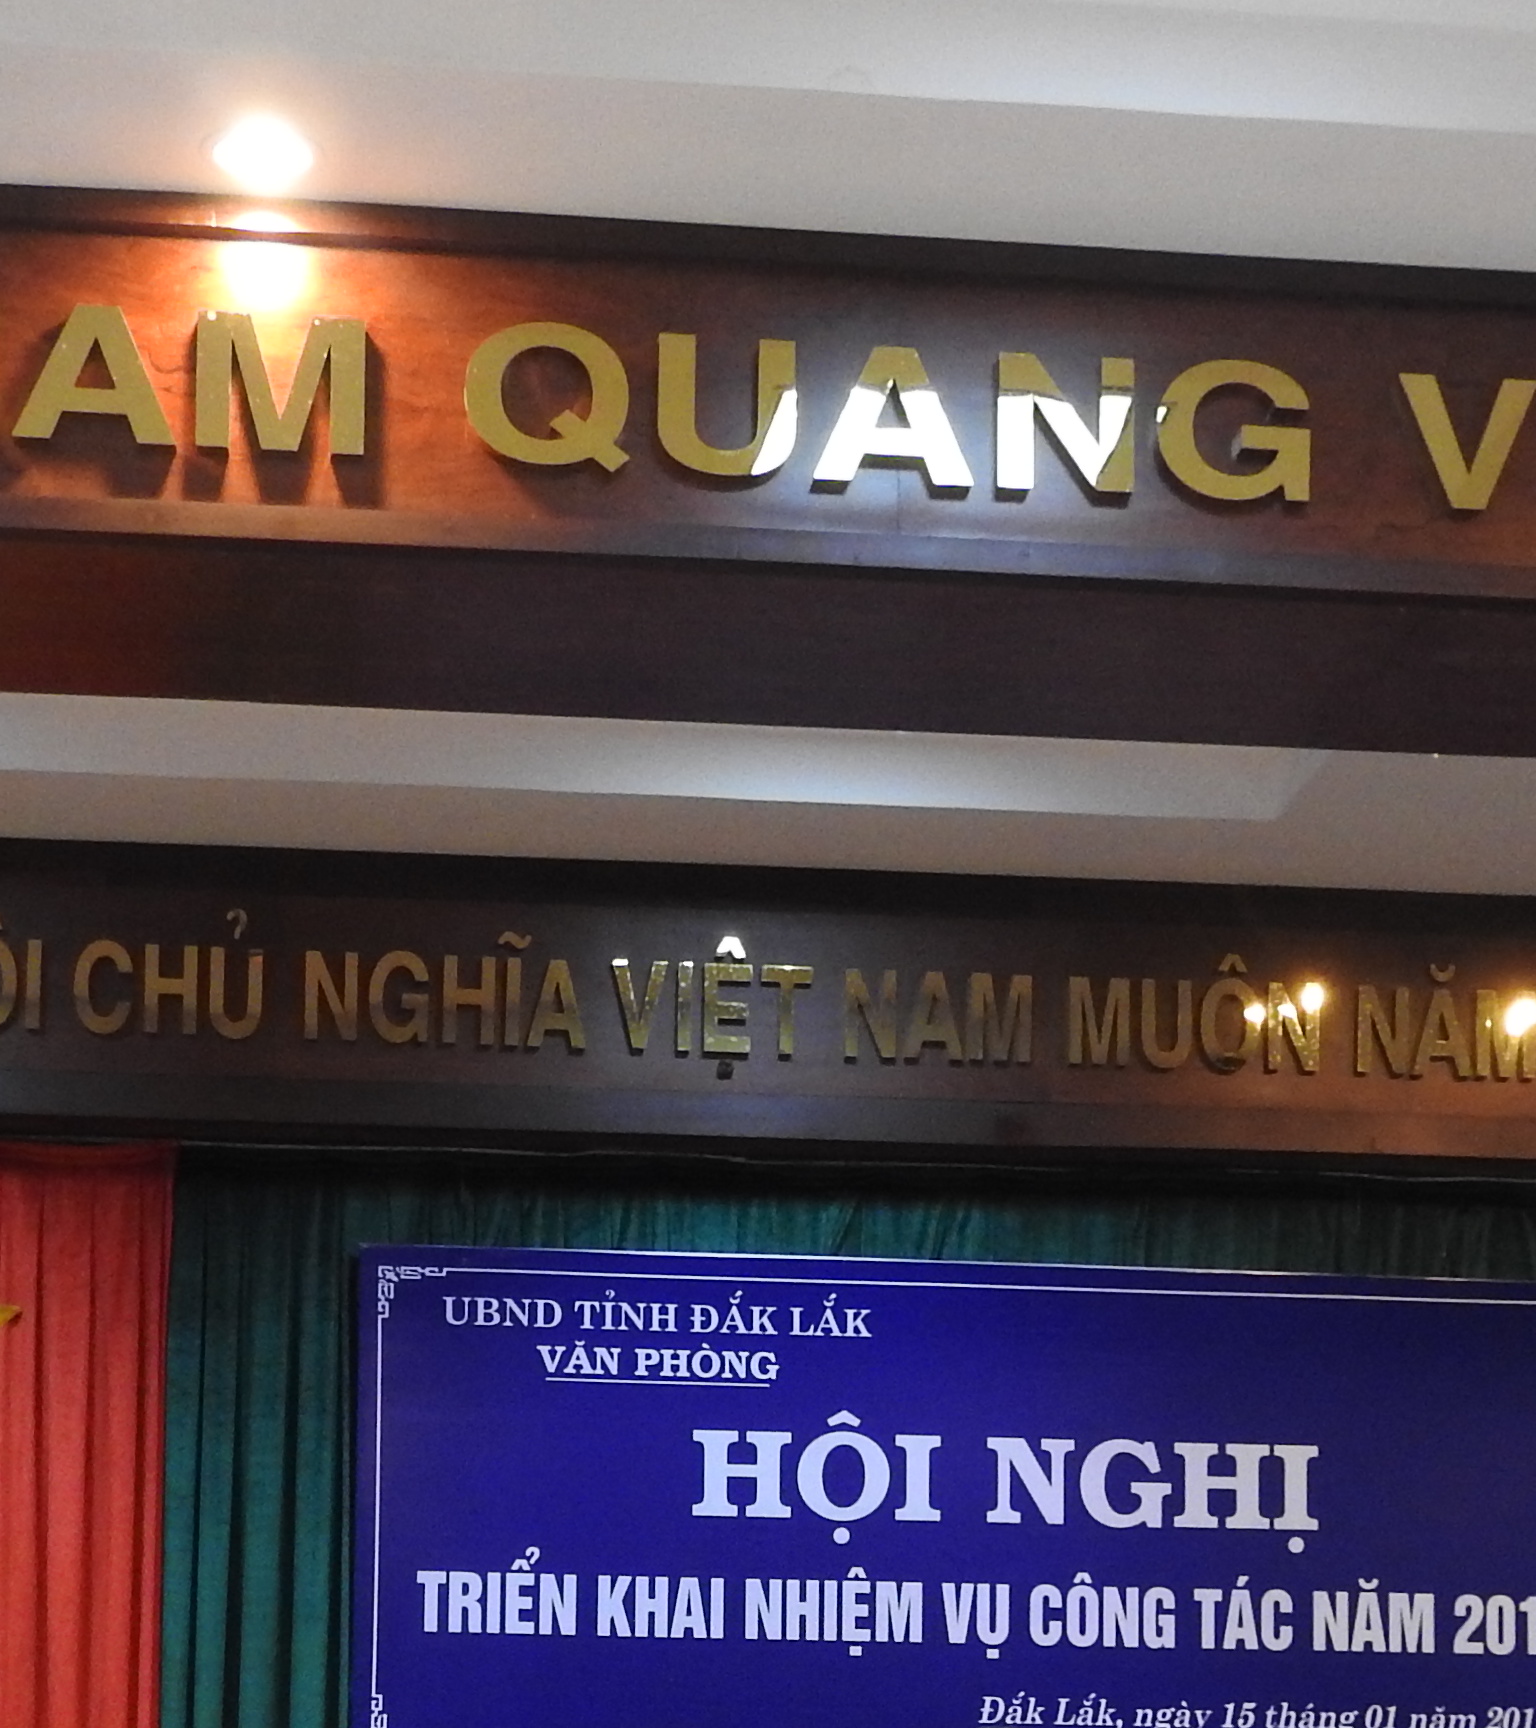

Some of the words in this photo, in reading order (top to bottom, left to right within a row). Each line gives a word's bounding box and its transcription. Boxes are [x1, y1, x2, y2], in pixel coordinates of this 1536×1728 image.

[464, 321, 1312, 503] QUANG
[74, 908, 265, 1040] CHỦ
[302, 932, 586, 1053] NGHĨA
[612, 935, 814, 1078] VIỆT
[844, 967, 1034, 1067] NAM
[1066, 955, 1322, 1075] MUÔN
[443, 1297, 562, 1327] UBND
[575, 1290, 678, 1331] TỈNH
[690, 1291, 778, 1334] ĐẮK
[790, 1295, 872, 1337] LẮK
[536, 1341, 621, 1375] VĂN
[635, 1343, 779, 1377] PHÒNG
[692, 1410, 941, 1544] HỘI
[987, 1437, 1318, 1553] NGHỊ
[417, 1547, 577, 1635] TRIỂN
[597, 1575, 724, 1638] KHAI
[745, 1567, 923, 1656] NHIỆM
[942, 1583, 1009, 1659] VỤ
[1030, 1572, 1175, 1648] CÔNG
[1194, 1576, 1293, 1651] TÁC
[1313, 1578, 1435, 1653] NĂM
[978, 1692, 1045, 1724] Đắk
[1222, 1703, 1256, 1728] 15
